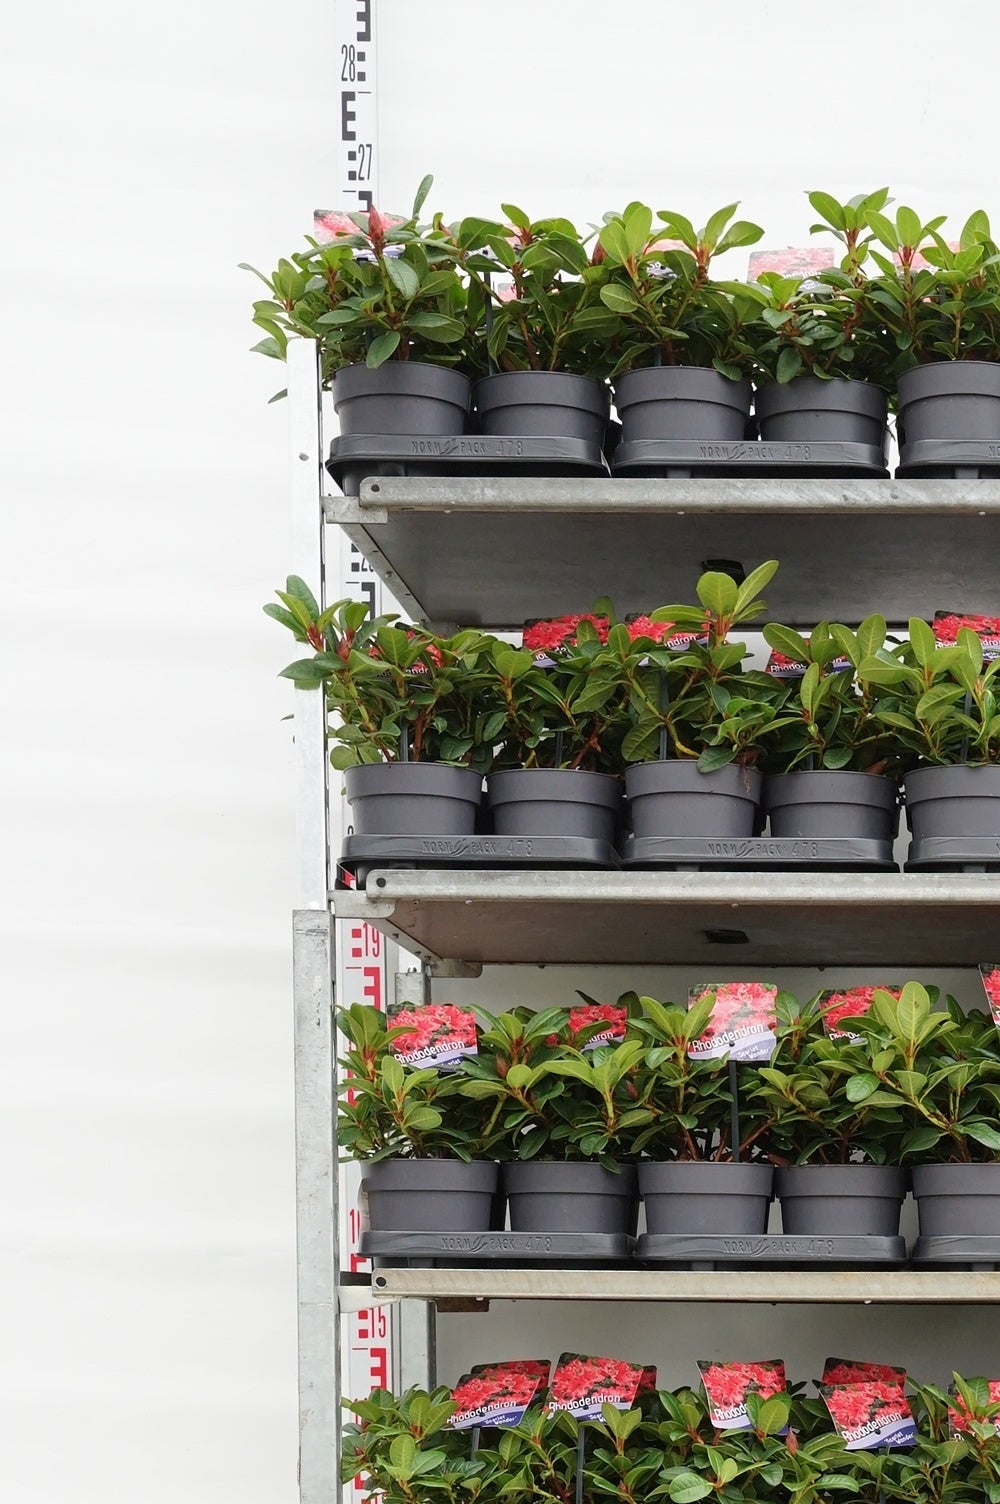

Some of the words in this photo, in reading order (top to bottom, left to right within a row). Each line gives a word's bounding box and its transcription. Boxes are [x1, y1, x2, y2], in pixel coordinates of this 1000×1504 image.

[341, 44, 356, 82] 28
[358, 143, 372, 181] 27
[362, 922, 381, 958] 19
[394, 1040, 465, 1065] Rhododendron
[692, 1023, 764, 1053] Rhododendron
[369, 1306, 386, 1339] 15
[548, 1393, 621, 1411] Rhododendron
[841, 1411, 901, 1442] Rhododendron
